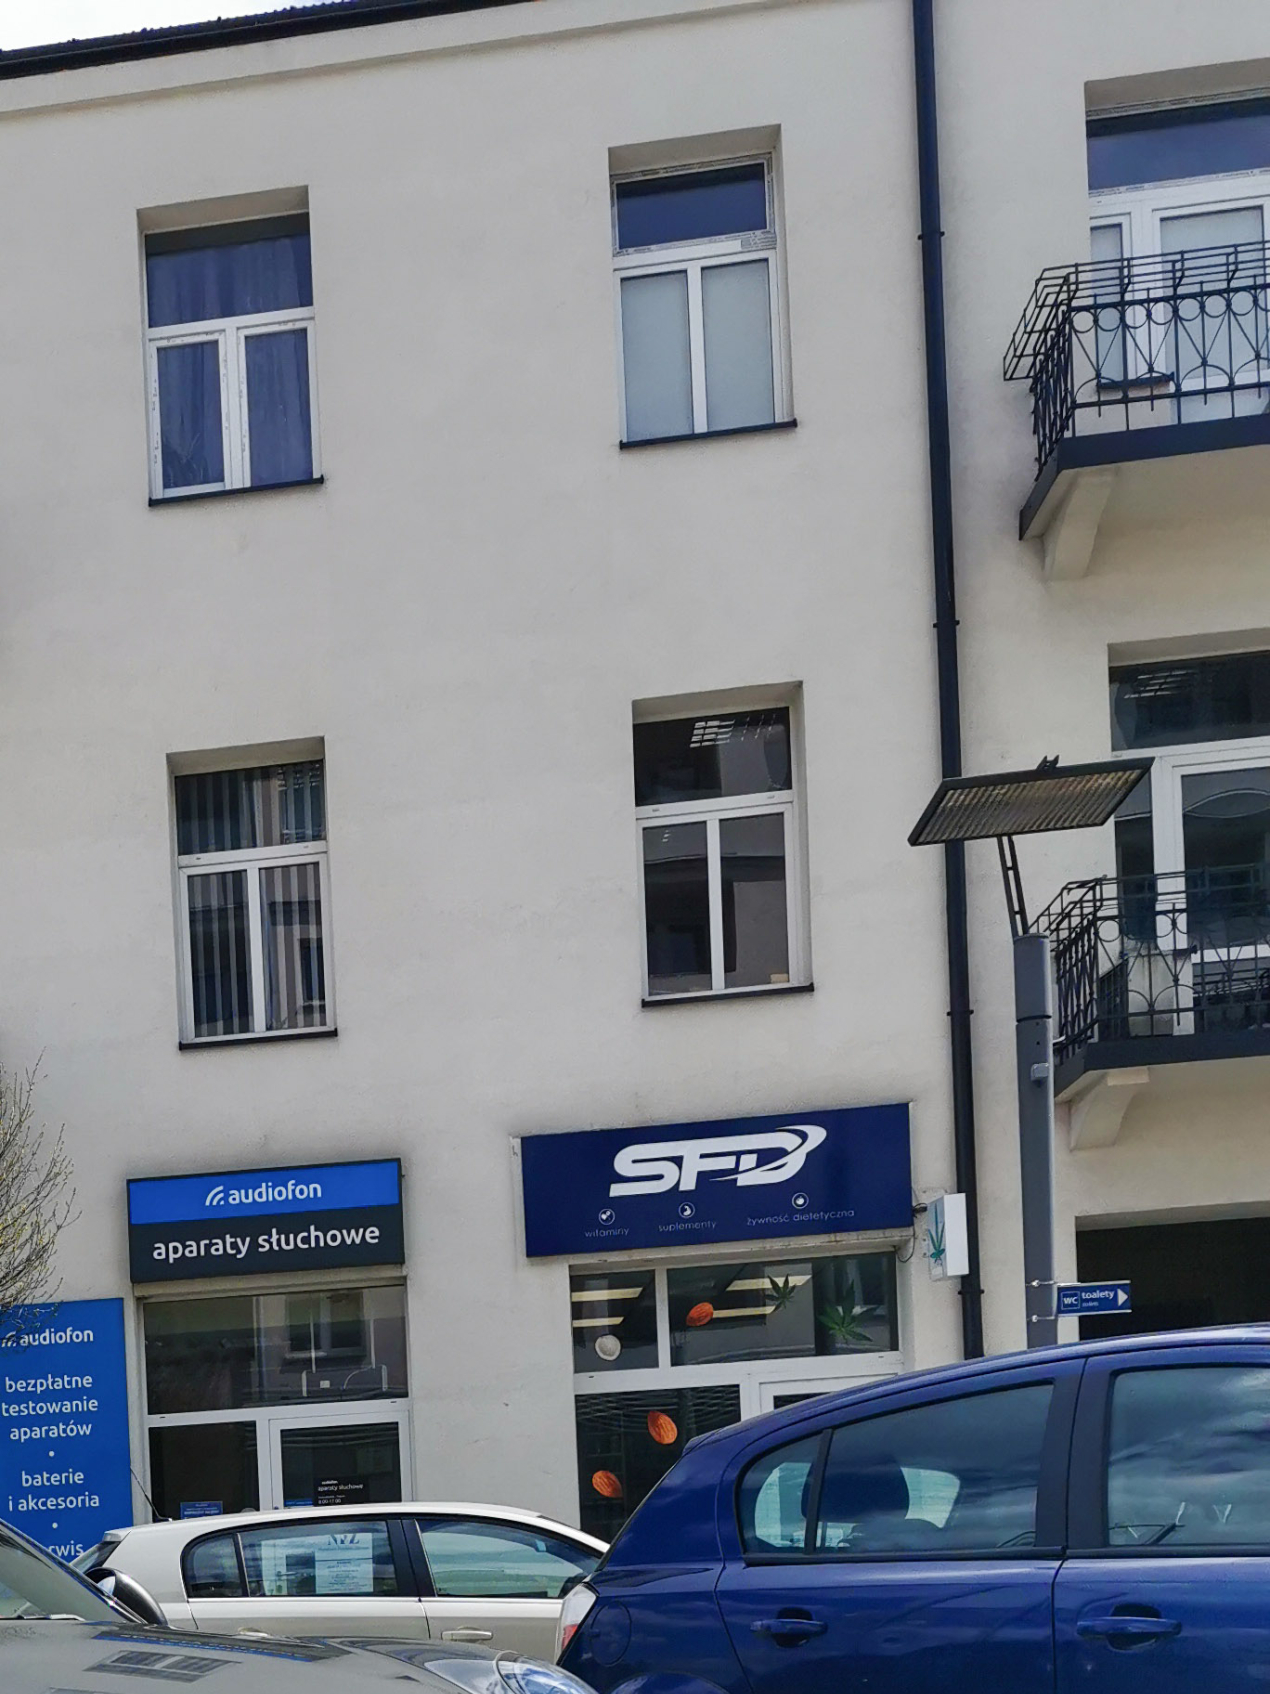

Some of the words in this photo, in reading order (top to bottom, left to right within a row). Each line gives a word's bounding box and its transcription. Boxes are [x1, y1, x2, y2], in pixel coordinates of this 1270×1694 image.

[609, 1124, 827, 1197] SFD
[228, 1180, 322, 1205] audiofon
[792, 1208, 855, 1222] dietetyczna
[584, 1226, 630, 1238] witaminy
[658, 1220, 717, 1232] suplementy
[152, 1235, 250, 1263] aparaty
[257, 1225, 380, 1253] słuchowe
[1063, 1296, 1078, 1305] WC
[1081, 1289, 1115, 1300] toalety
[19, 1327, 94, 1347] audiofon
[5, 1374, 93, 1394] bezpłatne
[1, 1396, 99, 1417] testowanie
[10, 1420, 92, 1443] aparatów
[21, 1468, 85, 1487] baterie
[8, 1496, 13, 1511] i
[18, 1491, 100, 1511] akcesoria
[48, 1540, 85, 1556] rwis
